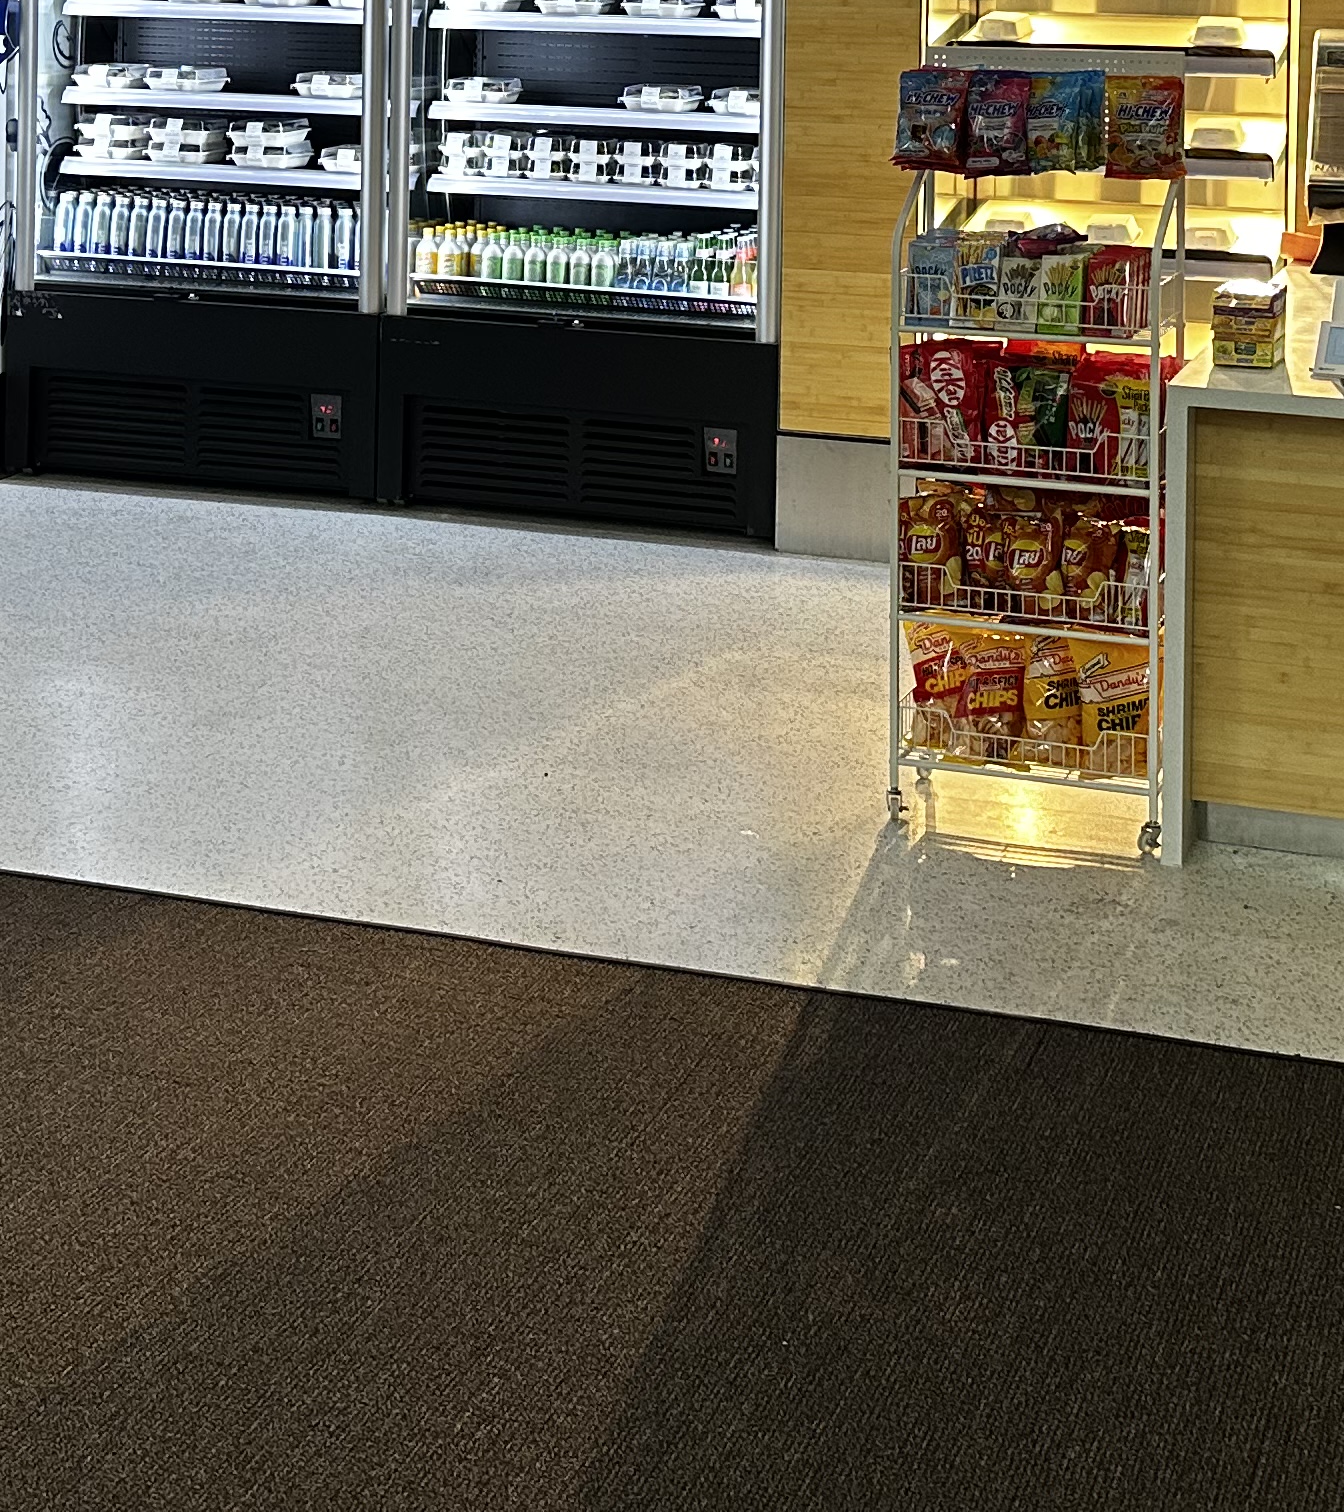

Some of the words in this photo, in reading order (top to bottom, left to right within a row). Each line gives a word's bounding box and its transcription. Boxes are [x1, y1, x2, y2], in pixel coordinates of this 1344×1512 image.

[905, 90, 960, 106] HI-CHEW
[968, 101, 1020, 118] HI-CHEW
[1116, 102, 1173, 120] HI-CHEW
[1003, 282, 1037, 298] POCKY
[1043, 282, 1078, 298] POCKY
[1122, 386, 1149, 402] Share
[965, 546, 982, 560] 20
[967, 690, 1018, 710] CHIPS
